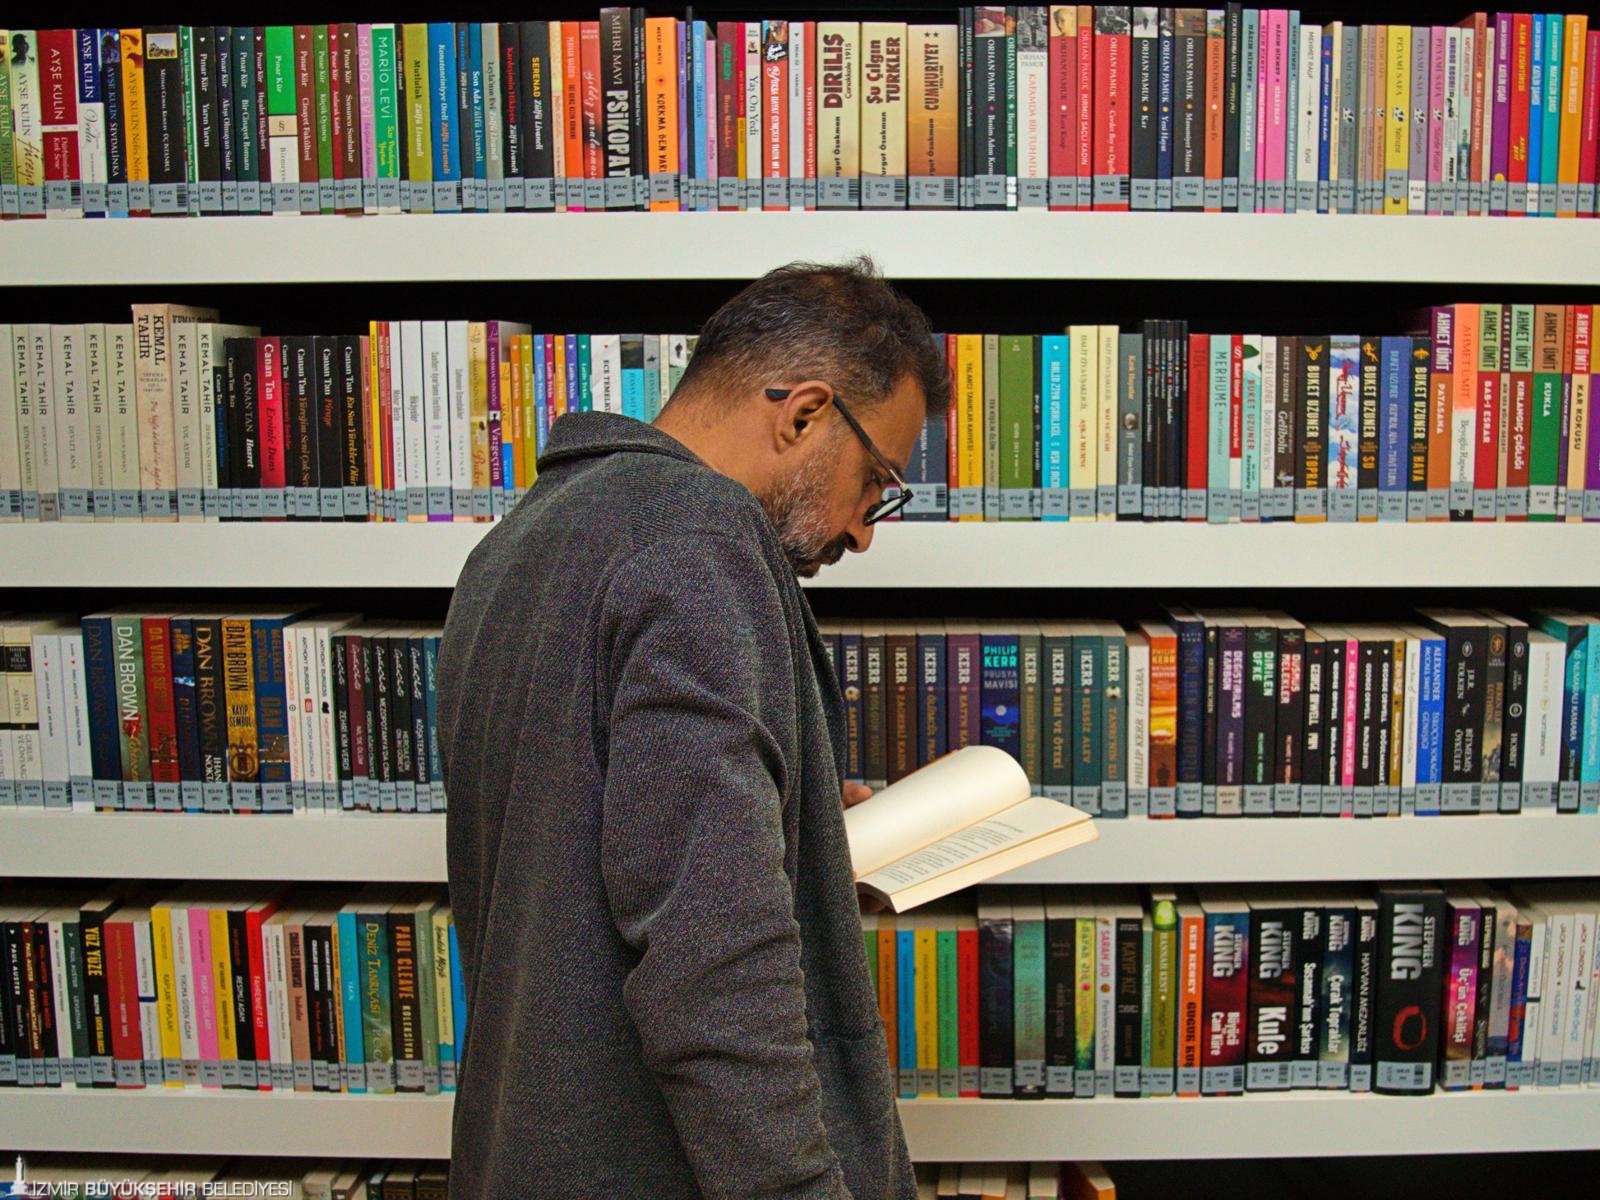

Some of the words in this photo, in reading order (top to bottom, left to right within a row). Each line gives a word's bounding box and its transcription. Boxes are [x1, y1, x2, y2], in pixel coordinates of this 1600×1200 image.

[81, 34, 92, 60] AYŞE
[378, 37, 390, 83] MARİO
[865, 40, 884, 81] Çılgın
[49, 49, 62, 79] AYŞE
[18, 73, 29, 100] AYŞE
[83, 64, 93, 98] KULİN
[867, 87, 882, 104] Şu
[53, 84, 65, 119] KULİN
[380, 89, 392, 118] LEVİ
[657, 93, 667, 130] KORKMA
[749, 95, 758, 111] On
[21, 104, 30, 136] KULİN
[242, 112, 250, 139] Cinayet
[749, 114, 758, 135] Yedi
[138, 315, 152, 359] TAHİR
[153, 315, 166, 366] KEMAL
[1437, 312, 1450, 344] AHMET
[1484, 310, 1497, 342] AHMET
[1516, 310, 1530, 341] AHMET
[1544, 312, 1557, 344] AHMET
[1575, 313, 1589, 345] AHMET
[17, 337, 25, 376] KEMAL
[35, 337, 44, 376] KEMAL
[64, 336, 72, 376] KEMAL
[90, 335, 98, 375] KEMAL
[115, 336, 125, 375] KEMAL
[178, 335, 187, 375] KEMAL
[202, 334, 210, 374] KEMAL
[264, 344, 273, 377] Canan
[297, 349, 306, 376] Canan
[323, 349, 331, 376] Canan
[345, 347, 353, 374] Canan
[1436, 348, 1450, 370] ÜMİT
[1482, 346, 1497, 368] ÜMİT
[1515, 346, 1530, 367] ÜMİT
[1543, 348, 1557, 370] ÜMİT
[1575, 348, 1588, 371] ÜMİT
[244, 373, 252, 409] CANAN
[266, 381, 274, 400] Tan
[298, 378, 307, 395] Tan
[346, 376, 354, 393] Tan
[1214, 352, 1227, 407] MERHUME
[1306, 366, 1320, 396] BUKET
[1363, 366, 1376, 396] BUKET
[1414, 367, 1427, 397] BUKET
[20, 382, 29, 415] TAHİR
[38, 382, 47, 415] TAHİR
[66, 381, 75, 415] TAHİR
[92, 380, 102, 414] TAHİR
[118, 381, 127, 415] TAHİR
[180, 380, 189, 414] TAHİR
[203, 380, 212, 413] TAHİR
[1543, 382, 1551, 416] KUKLA
[1306, 400, 1319, 437] UZUNER
[1363, 400, 1375, 438] UZUNER
[1414, 401, 1426, 439] UZUNER
[1363, 456, 1375, 469] SU
[1413, 456, 1424, 481] HAVA
[117, 626, 134, 660] DAN
[197, 626, 213, 669] DAN
[226, 626, 246, 647] DAN
[984, 646, 1017, 655] PHILIP
[229, 653, 248, 691] BROWN
[868, 652, 880, 684] KERR
[895, 652, 907, 683] KERR
[925, 652, 936, 683] KERR
[958, 652, 970, 684] KERR
[984, 656, 1017, 668] KERR
[1025, 654, 1036, 684] KERR
[1052, 654, 1064, 685] KERR
[1081, 655, 1093, 686] KERR
[1108, 650, 1119, 681] KERR
[120, 662, 139, 720] BROWN
[85, 927, 99, 946] YÜZ
[396, 926, 411, 953] PAUL
[1302, 912, 1315, 939] KING
[1328, 915, 1344, 951] KING
[1360, 916, 1371, 942] KING
[1458, 916, 1471, 946] KING
[10, 944, 18, 967] PAUL
[1101, 930, 1110, 960] SARAH
[1159, 932, 1168, 969] HANNAH
[1212, 925, 1234, 977] KING
[1259, 922, 1282, 978] KING
[1391, 904, 1424, 980] KING
[1423, 917, 1435, 968] STEPHEN
[87, 951, 102, 976] YÜZE
[398, 958, 414, 998] CLEAVE
[1101, 963, 1110, 978] JIO
[1360, 953, 1370, 995] HAYVAN
[12, 967, 21, 995] AUSTER
[1159, 970, 1167, 993] KENT
[1328, 975, 1344, 1004] Çorak
[1257, 1007, 1286, 1054] Kule
[1327, 1008, 1342, 1053] Topraklar
